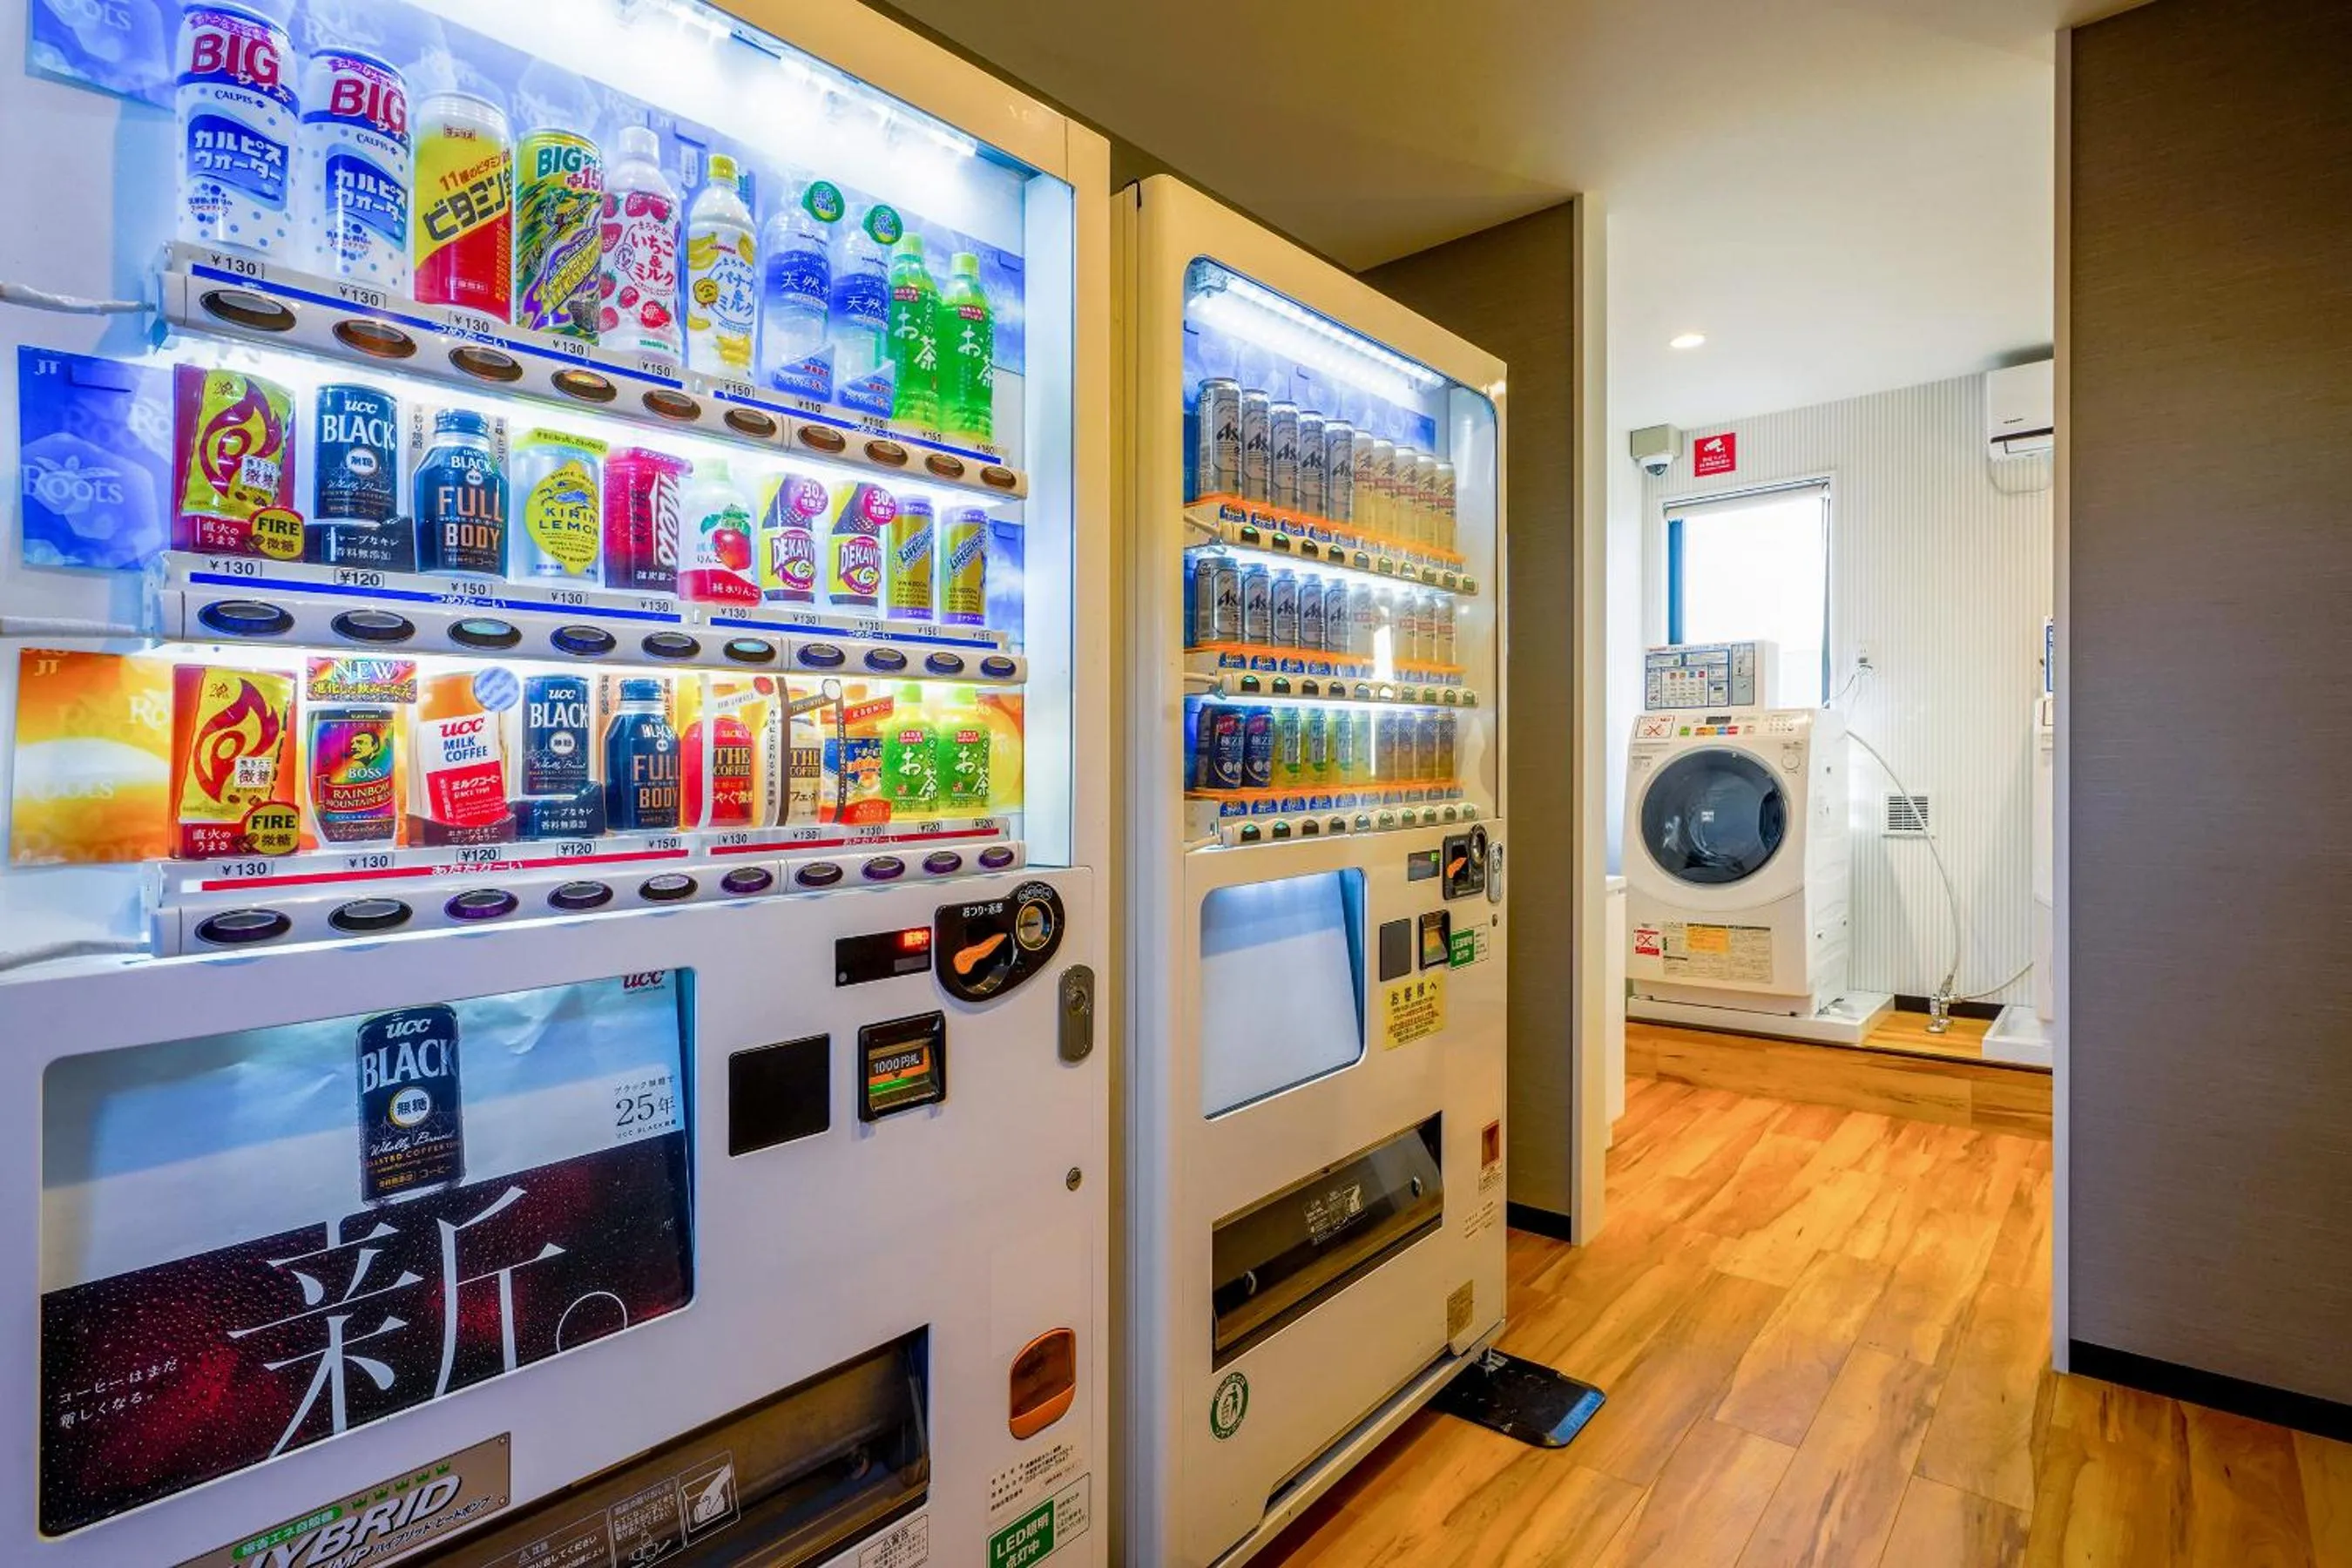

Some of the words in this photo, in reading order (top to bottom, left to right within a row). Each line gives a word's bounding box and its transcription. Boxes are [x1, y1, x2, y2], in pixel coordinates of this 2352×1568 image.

[190, 32, 280, 87] BIG
[214, 90, 253, 105] CALPIS
[330, 79, 406, 132] BIG
[194, 130, 282, 167] カルピス
[537, 145, 583, 178] BIG
[335, 169, 406, 210] カルピス
[631, 232, 675, 258] いちご
[212, 253, 256, 276] ¥130
[633, 262, 675, 287] ミルク
[339, 285, 380, 307] ¥130
[453, 314, 490, 335] ¥130
[552, 338, 585, 355] ¥130
[35, 359, 60, 375] JT
[642, 361, 671, 378] ¥150
[724, 382, 751, 398] ¥150
[322, 415, 395, 450] BLACK
[451, 456, 494, 475] BLACK
[438, 486, 504, 522] FULL
[545, 508, 596, 523] KIRIN
[202, 522, 240, 536] 直火の
[258, 517, 301, 537] FIRE
[539, 520, 598, 537] LEMON
[206, 534, 237, 546] うまさ
[267, 536, 294, 552] 微糖
[445, 524, 500, 551] BODY
[210, 560, 254, 576] ¥130
[340, 571, 379, 586] ¥120
[451, 583, 486, 596] ¥150
[551, 592, 583, 605] ¥130
[641, 600, 669, 612] ¥130
[720, 608, 747, 618] ¥130
[35, 659, 60, 677] JT
[332, 660, 397, 680] NEW
[530, 702, 590, 729] BLACK
[443, 735, 476, 752] MILK
[445, 745, 489, 763] COFFEE
[714, 747, 750, 766] THE
[790, 749, 820, 766] THE
[348, 767, 382, 780] BOSS
[633, 754, 679, 782] FULL
[713, 766, 750, 776] COFFEE
[333, 781, 389, 799] RAINBOW
[639, 787, 679, 808] BODY
[252, 814, 295, 828] FIRE
[193, 828, 231, 841] 直火の
[261, 833, 292, 847] 微糖
[722, 834, 747, 845] ¥130
[197, 841, 229, 852] うまさ
[560, 843, 592, 856] ¥120
[648, 838, 677, 850] ¥150
[349, 855, 389, 868] ¥130
[462, 848, 497, 862] ¥120
[222, 862, 267, 876] ¥130
[362, 1038, 458, 1095] BLACK
[396, 1097, 427, 1115] 無糖
[616, 1092, 676, 1126] 25年
